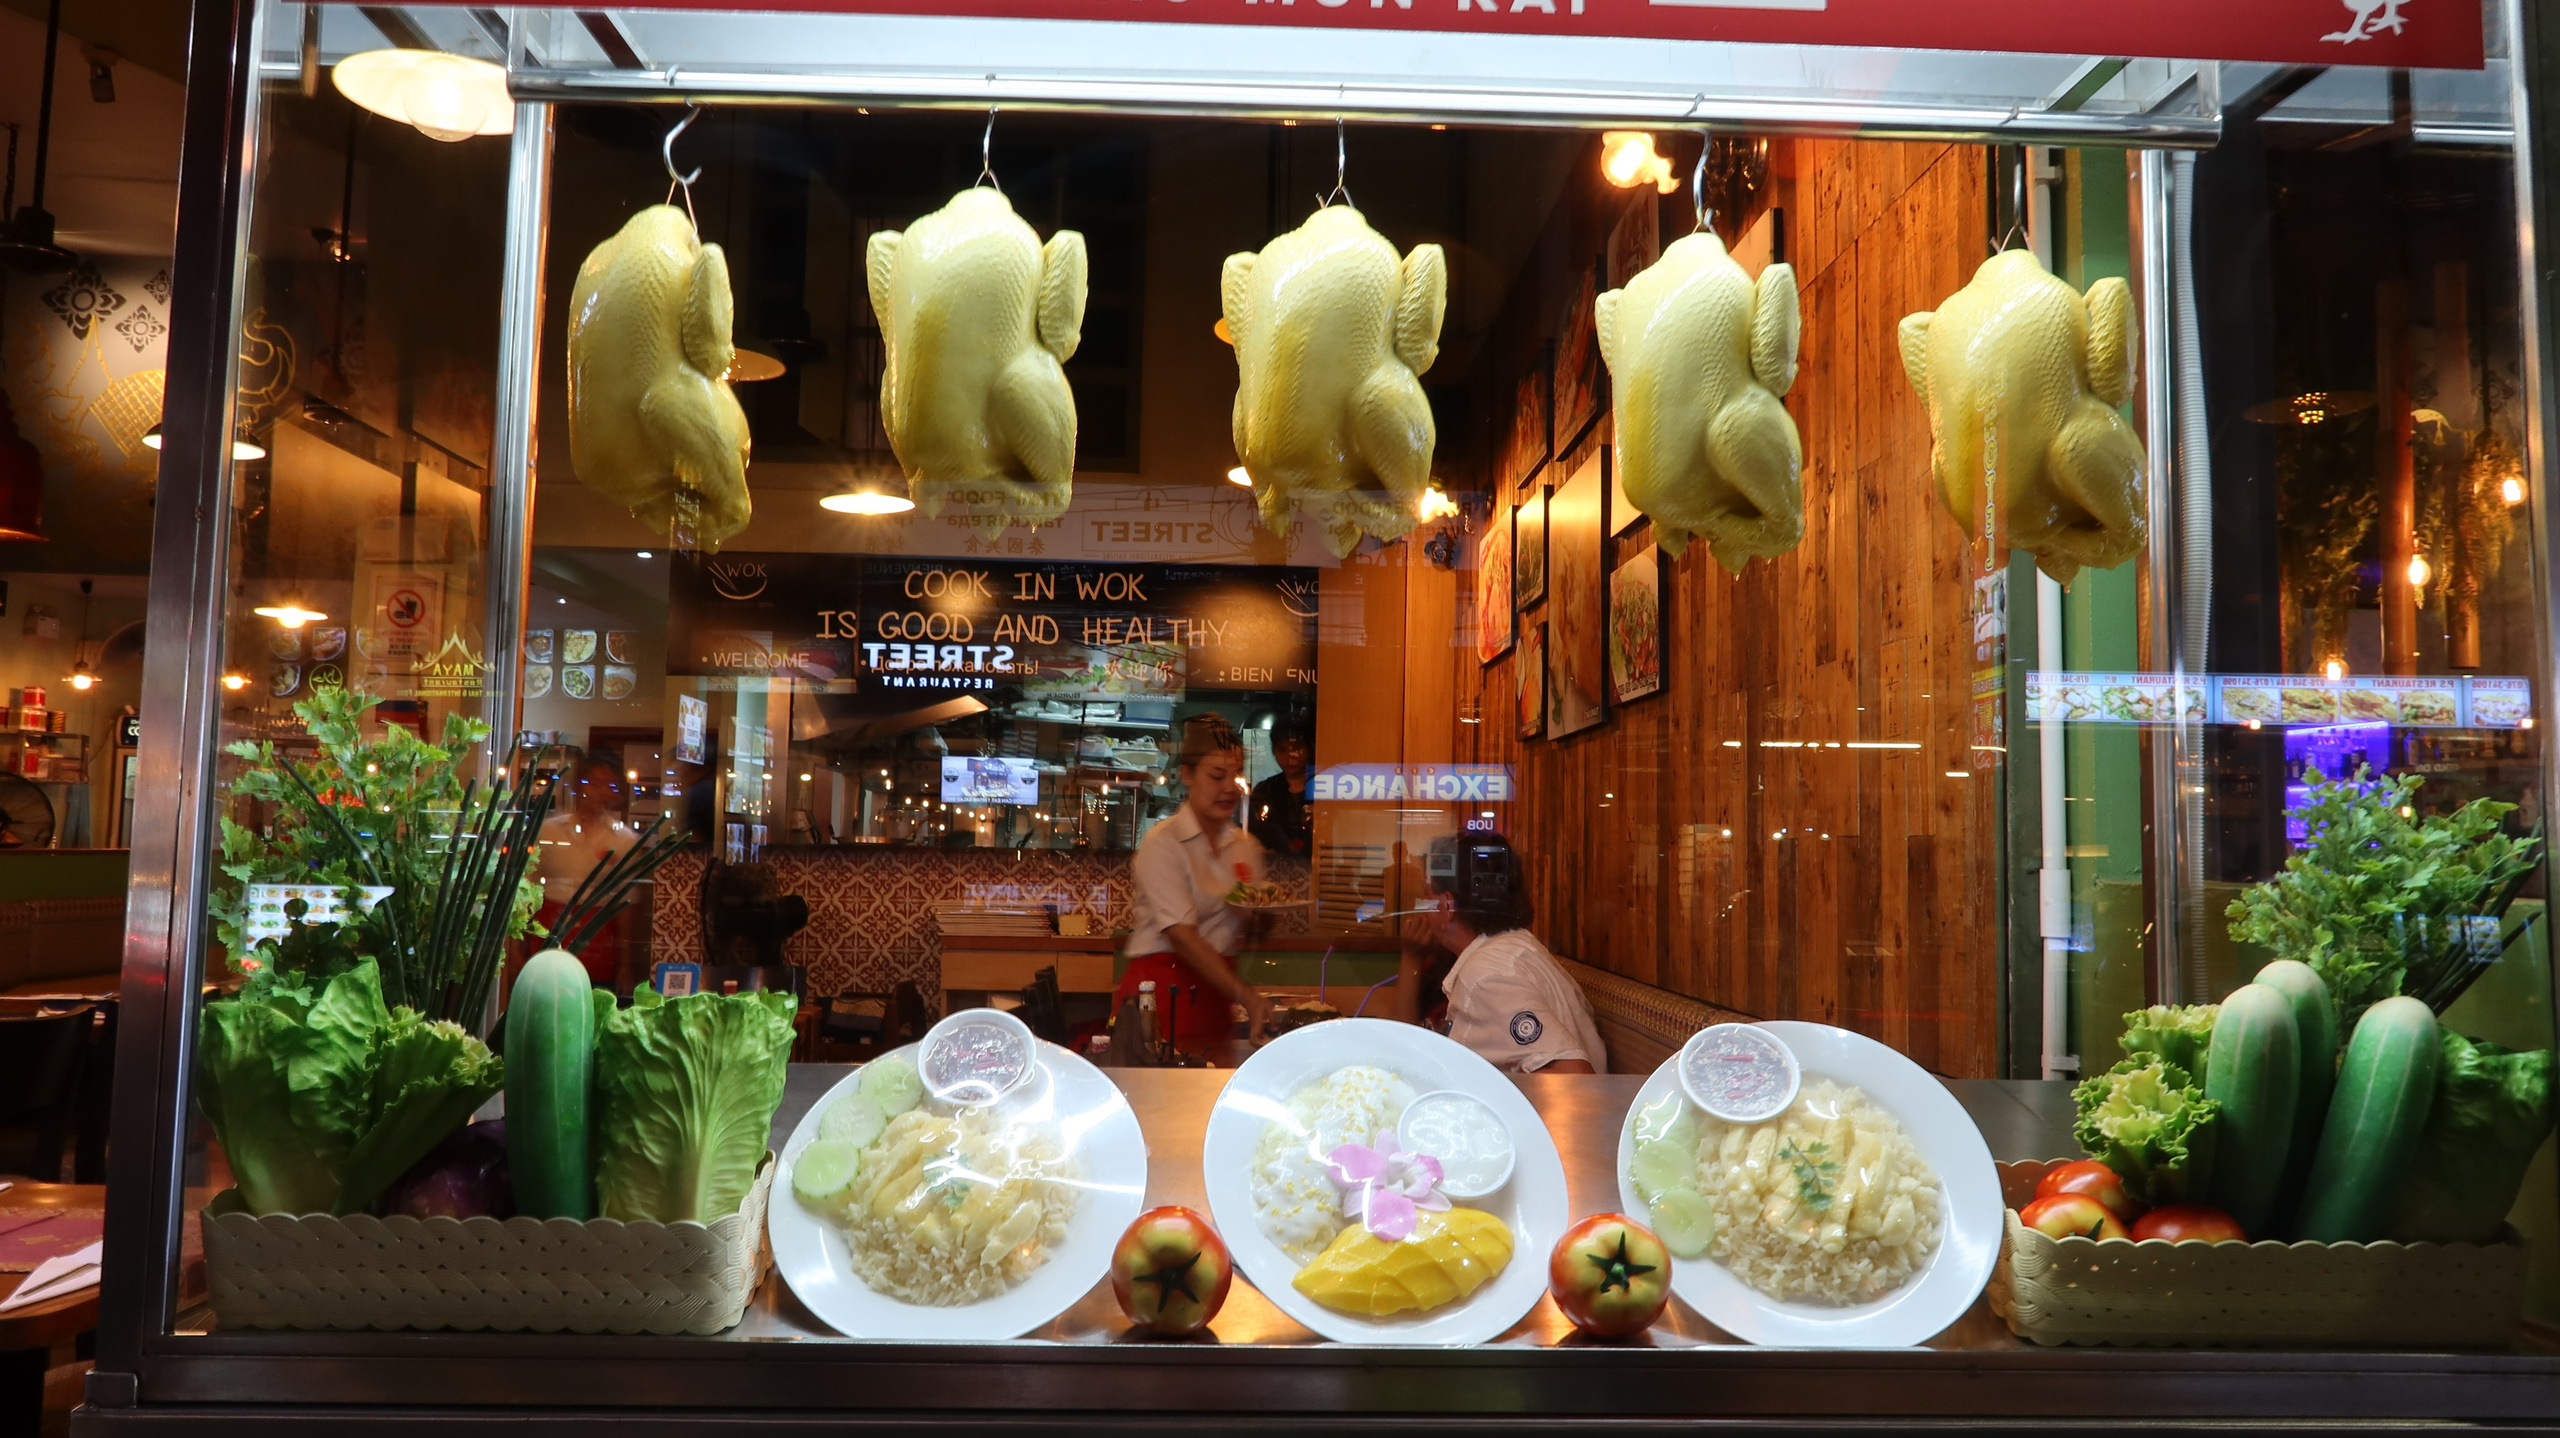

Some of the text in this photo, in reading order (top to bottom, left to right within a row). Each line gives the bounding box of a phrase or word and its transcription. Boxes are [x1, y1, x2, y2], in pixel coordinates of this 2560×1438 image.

[726, 562, 767, 578] WOK
[904, 570, 1147, 601] COOK IN WOK
[1294, 580, 1319, 595] WO
[816, 610, 1229, 647] IS GOOD AND HEALTHY
[713, 652, 810, 668] WELCOME
[1103, 659, 1175, 684] 欢迎你
